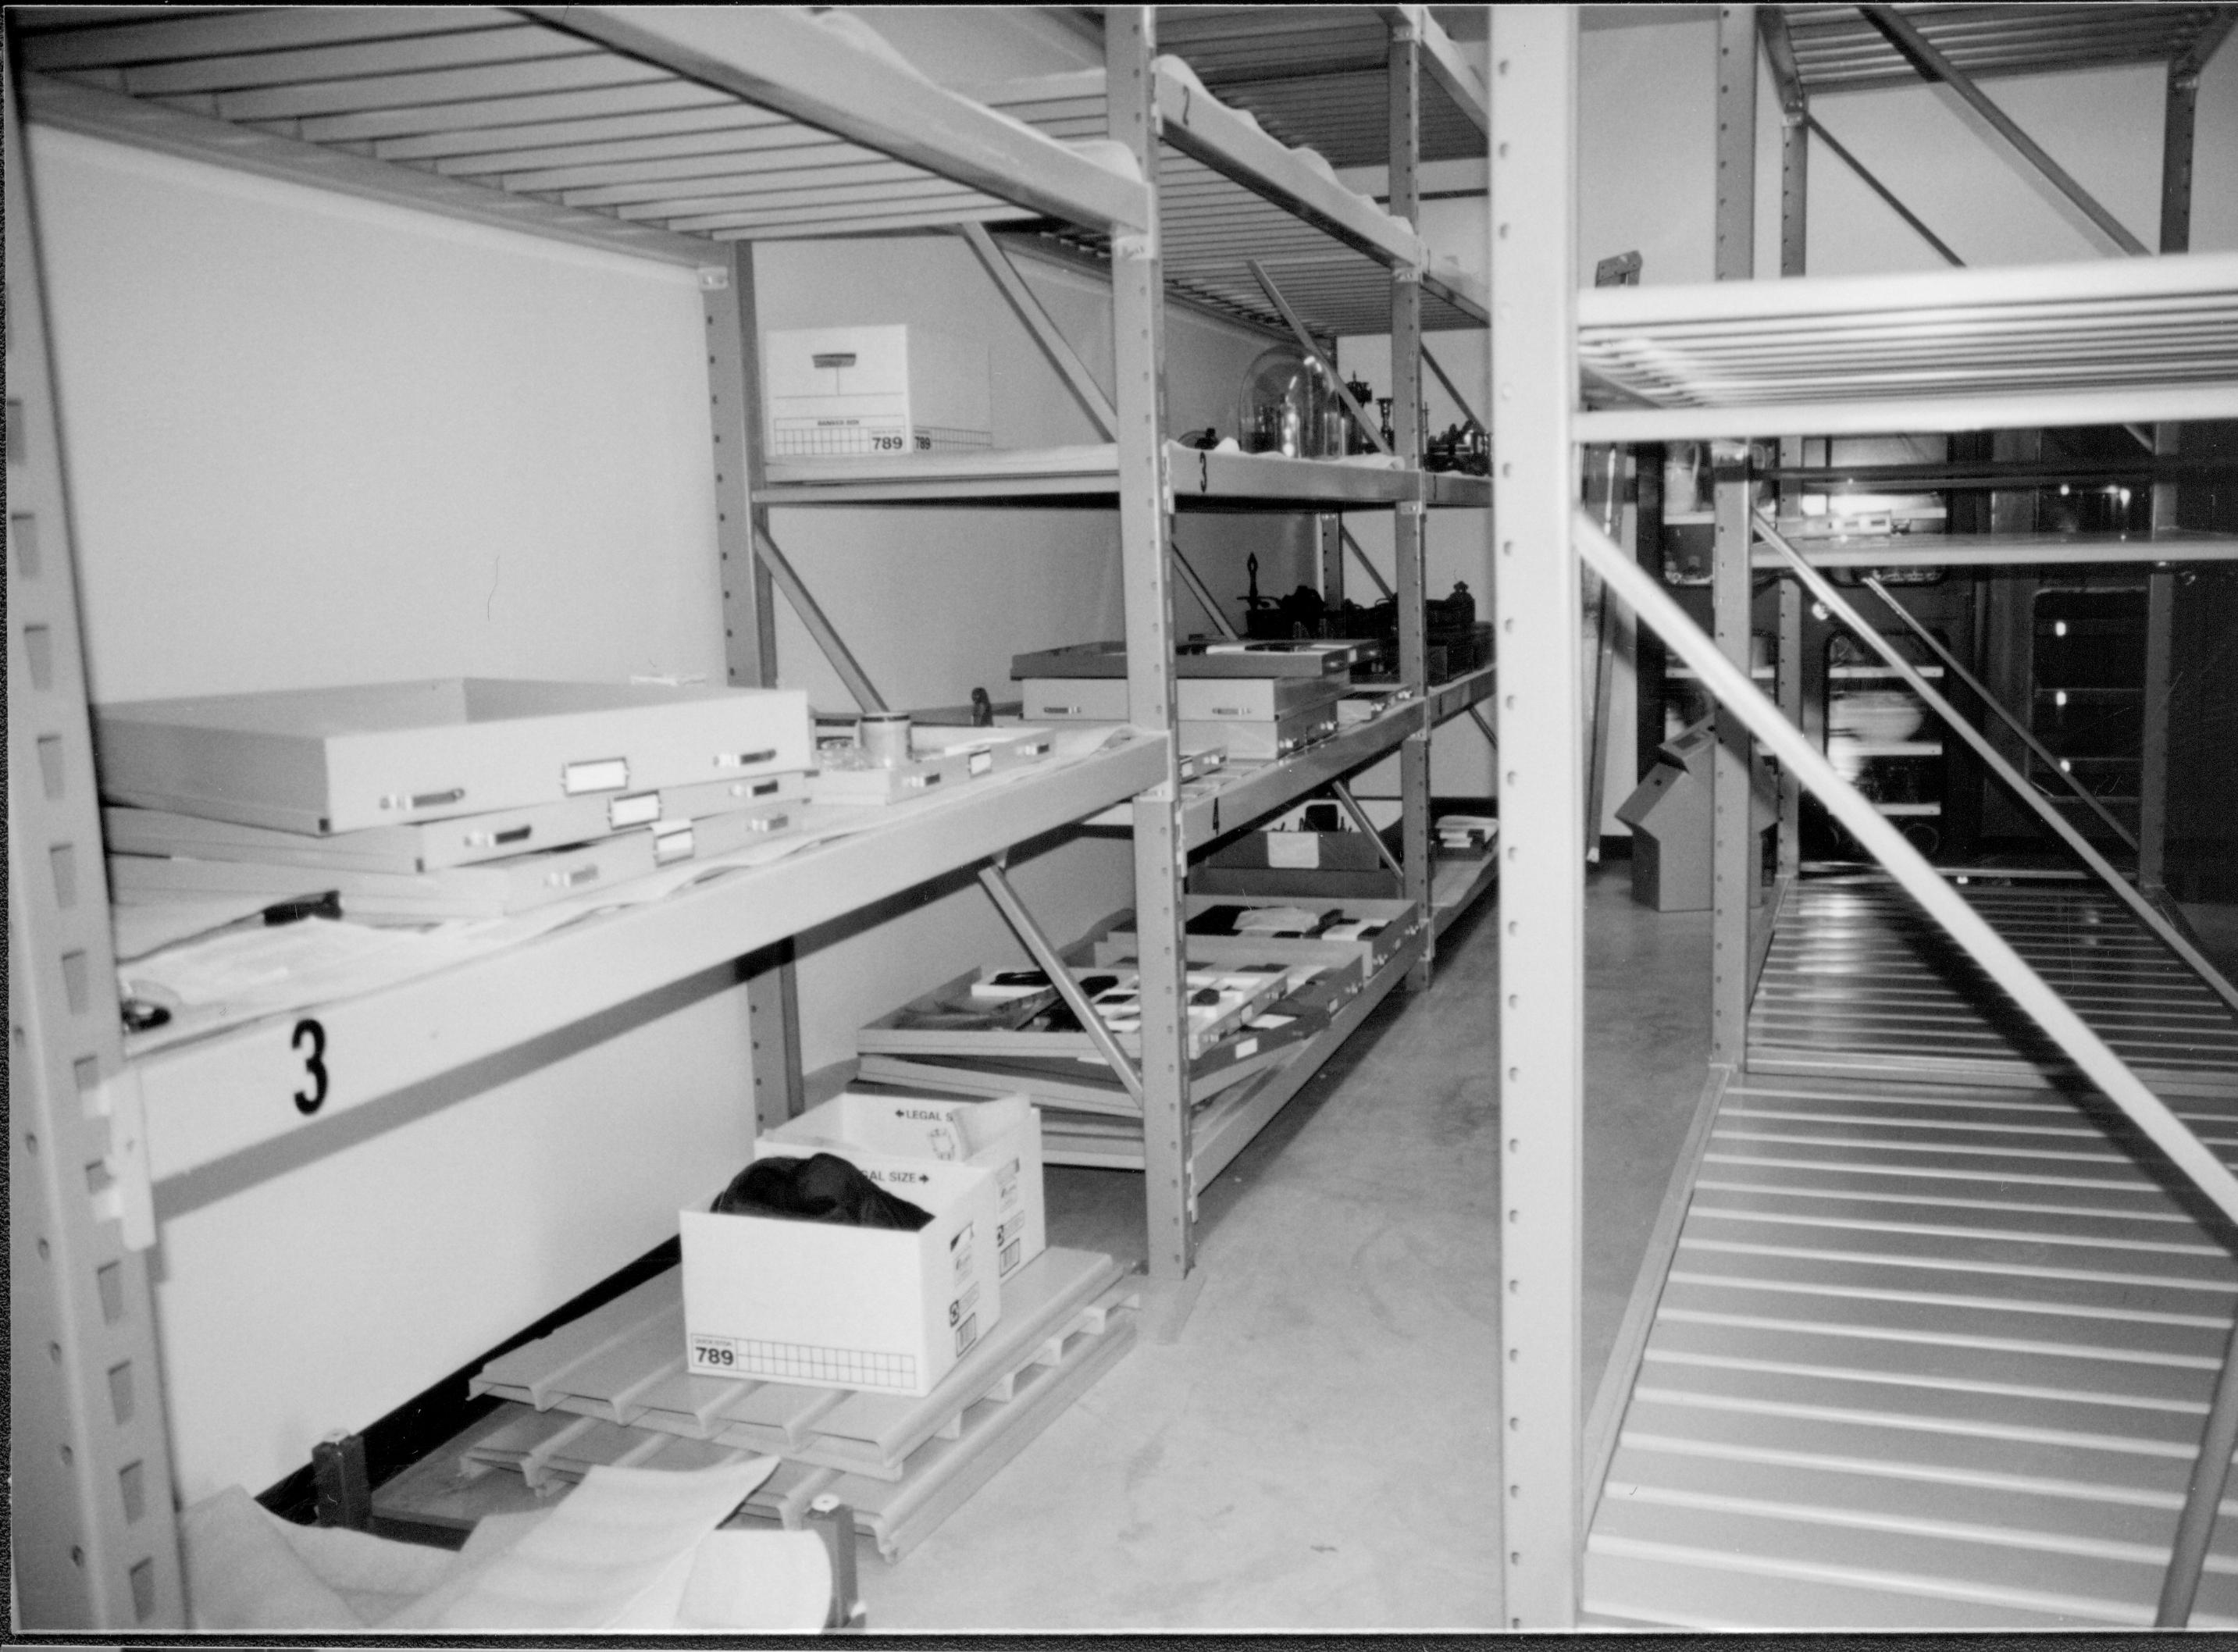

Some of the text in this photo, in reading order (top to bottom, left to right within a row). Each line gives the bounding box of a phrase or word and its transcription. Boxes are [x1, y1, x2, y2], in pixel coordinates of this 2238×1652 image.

[872, 436, 903, 450] 789
[914, 436, 932, 450] 789
[1199, 450, 1208, 493] 3
[291, 1018, 329, 1116] 3
[906, 1109, 942, 1122] LEGAL
[889, 1171, 917, 1184] SIZE
[695, 1346, 735, 1366] 789
